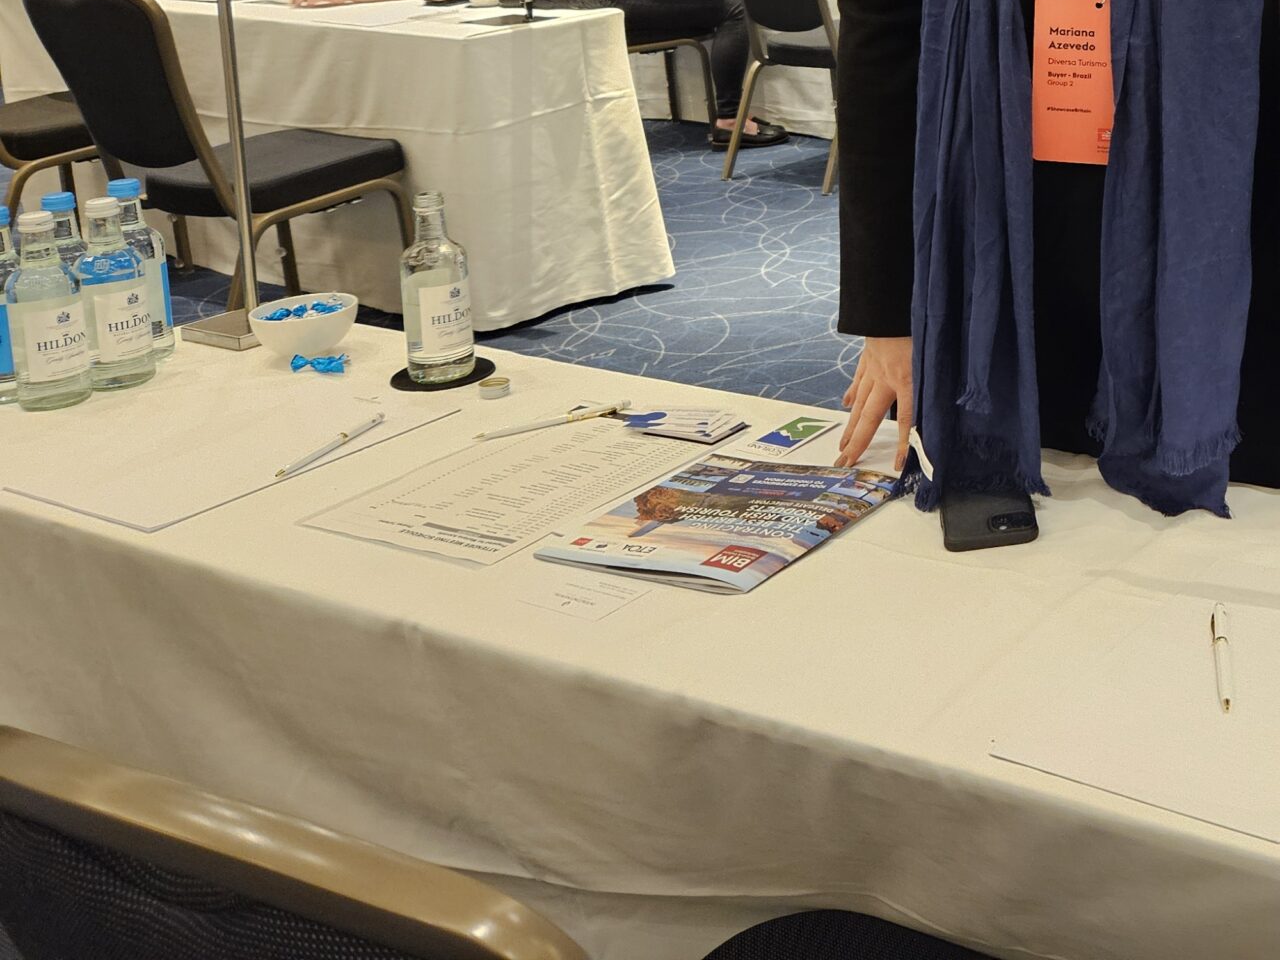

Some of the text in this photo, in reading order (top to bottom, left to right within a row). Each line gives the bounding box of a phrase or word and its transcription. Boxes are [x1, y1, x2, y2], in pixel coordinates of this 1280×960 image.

[1049, 27, 1095, 38] Mariana
[1048, 41, 1096, 52] Azevedo
[1047, 58, 1107, 68] Diversa Turismo
[1047, 71, 1067, 80] Buyer
[1072, 72, 1092, 80] Brazil
[1047, 79, 1068, 87] Group
[673, 505, 817, 526] AND IRISH TOURISM
[747, 504, 826, 520] PRODUCTS
[678, 513, 804, 533] THE BEST BRITISH
[690, 522, 795, 540] CONTRACTING
[622, 544, 657, 554] ETOA
[710, 553, 751, 568] BIM
